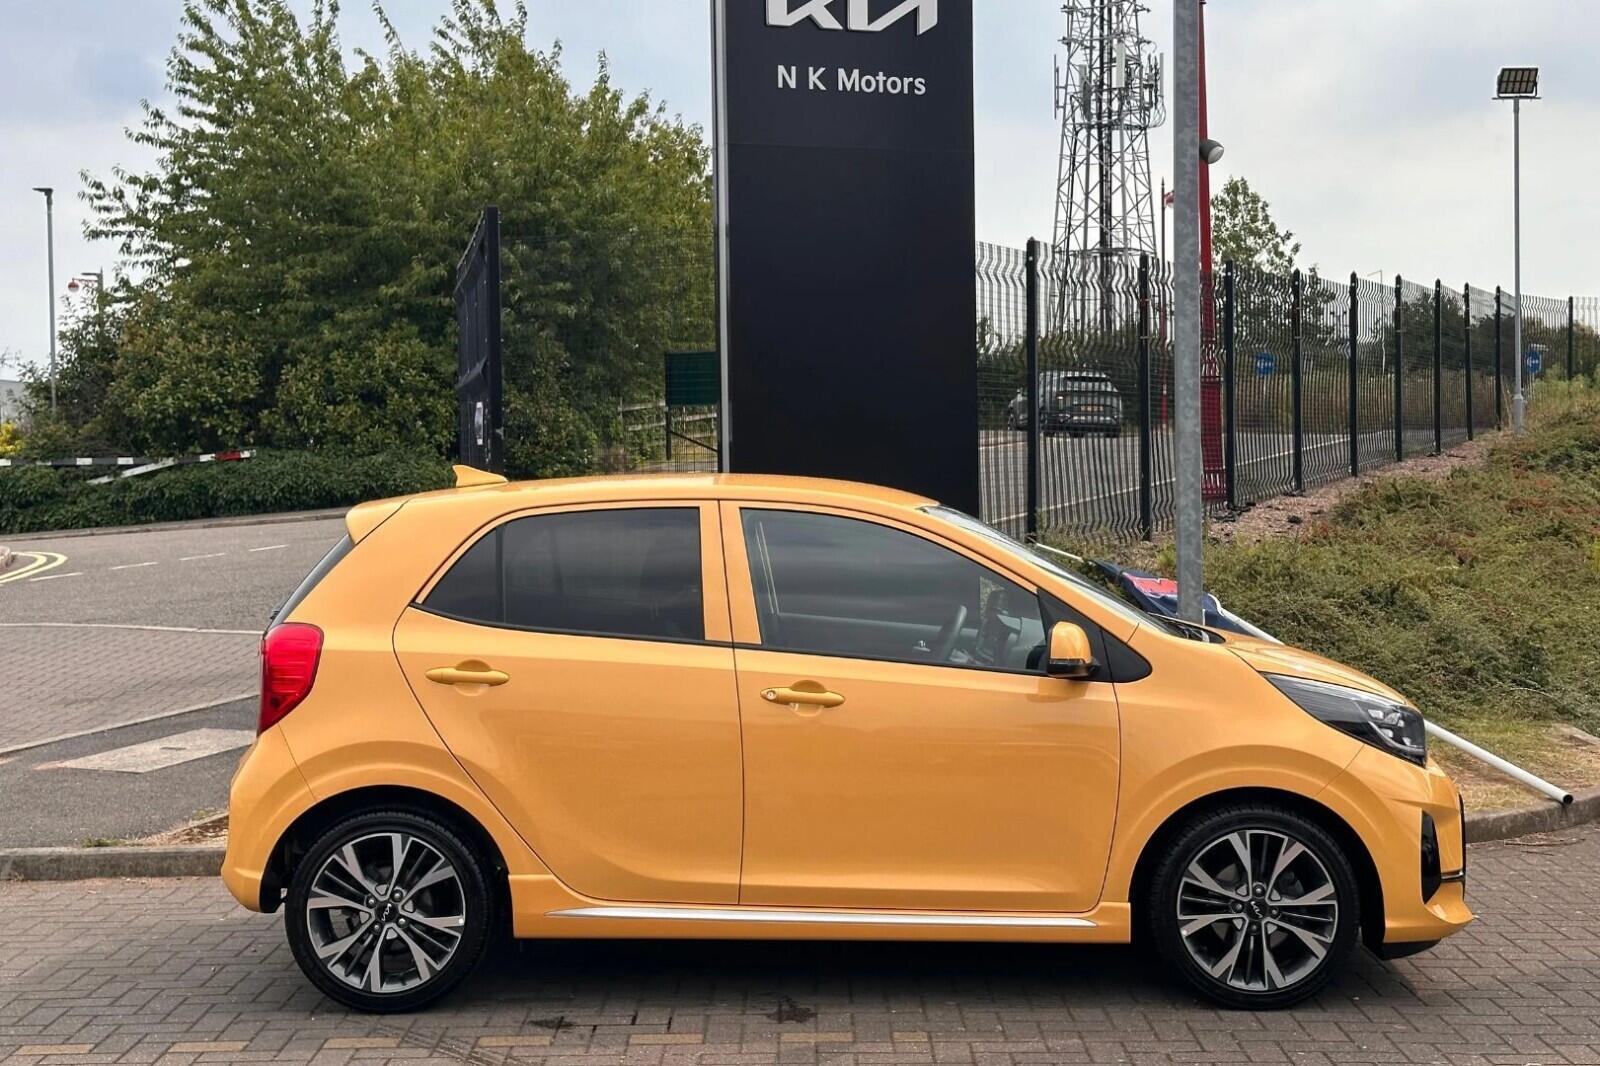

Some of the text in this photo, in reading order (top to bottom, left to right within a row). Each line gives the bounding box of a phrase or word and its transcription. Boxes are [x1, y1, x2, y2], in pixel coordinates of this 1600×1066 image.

[777, 64, 926, 95] N K Motors
